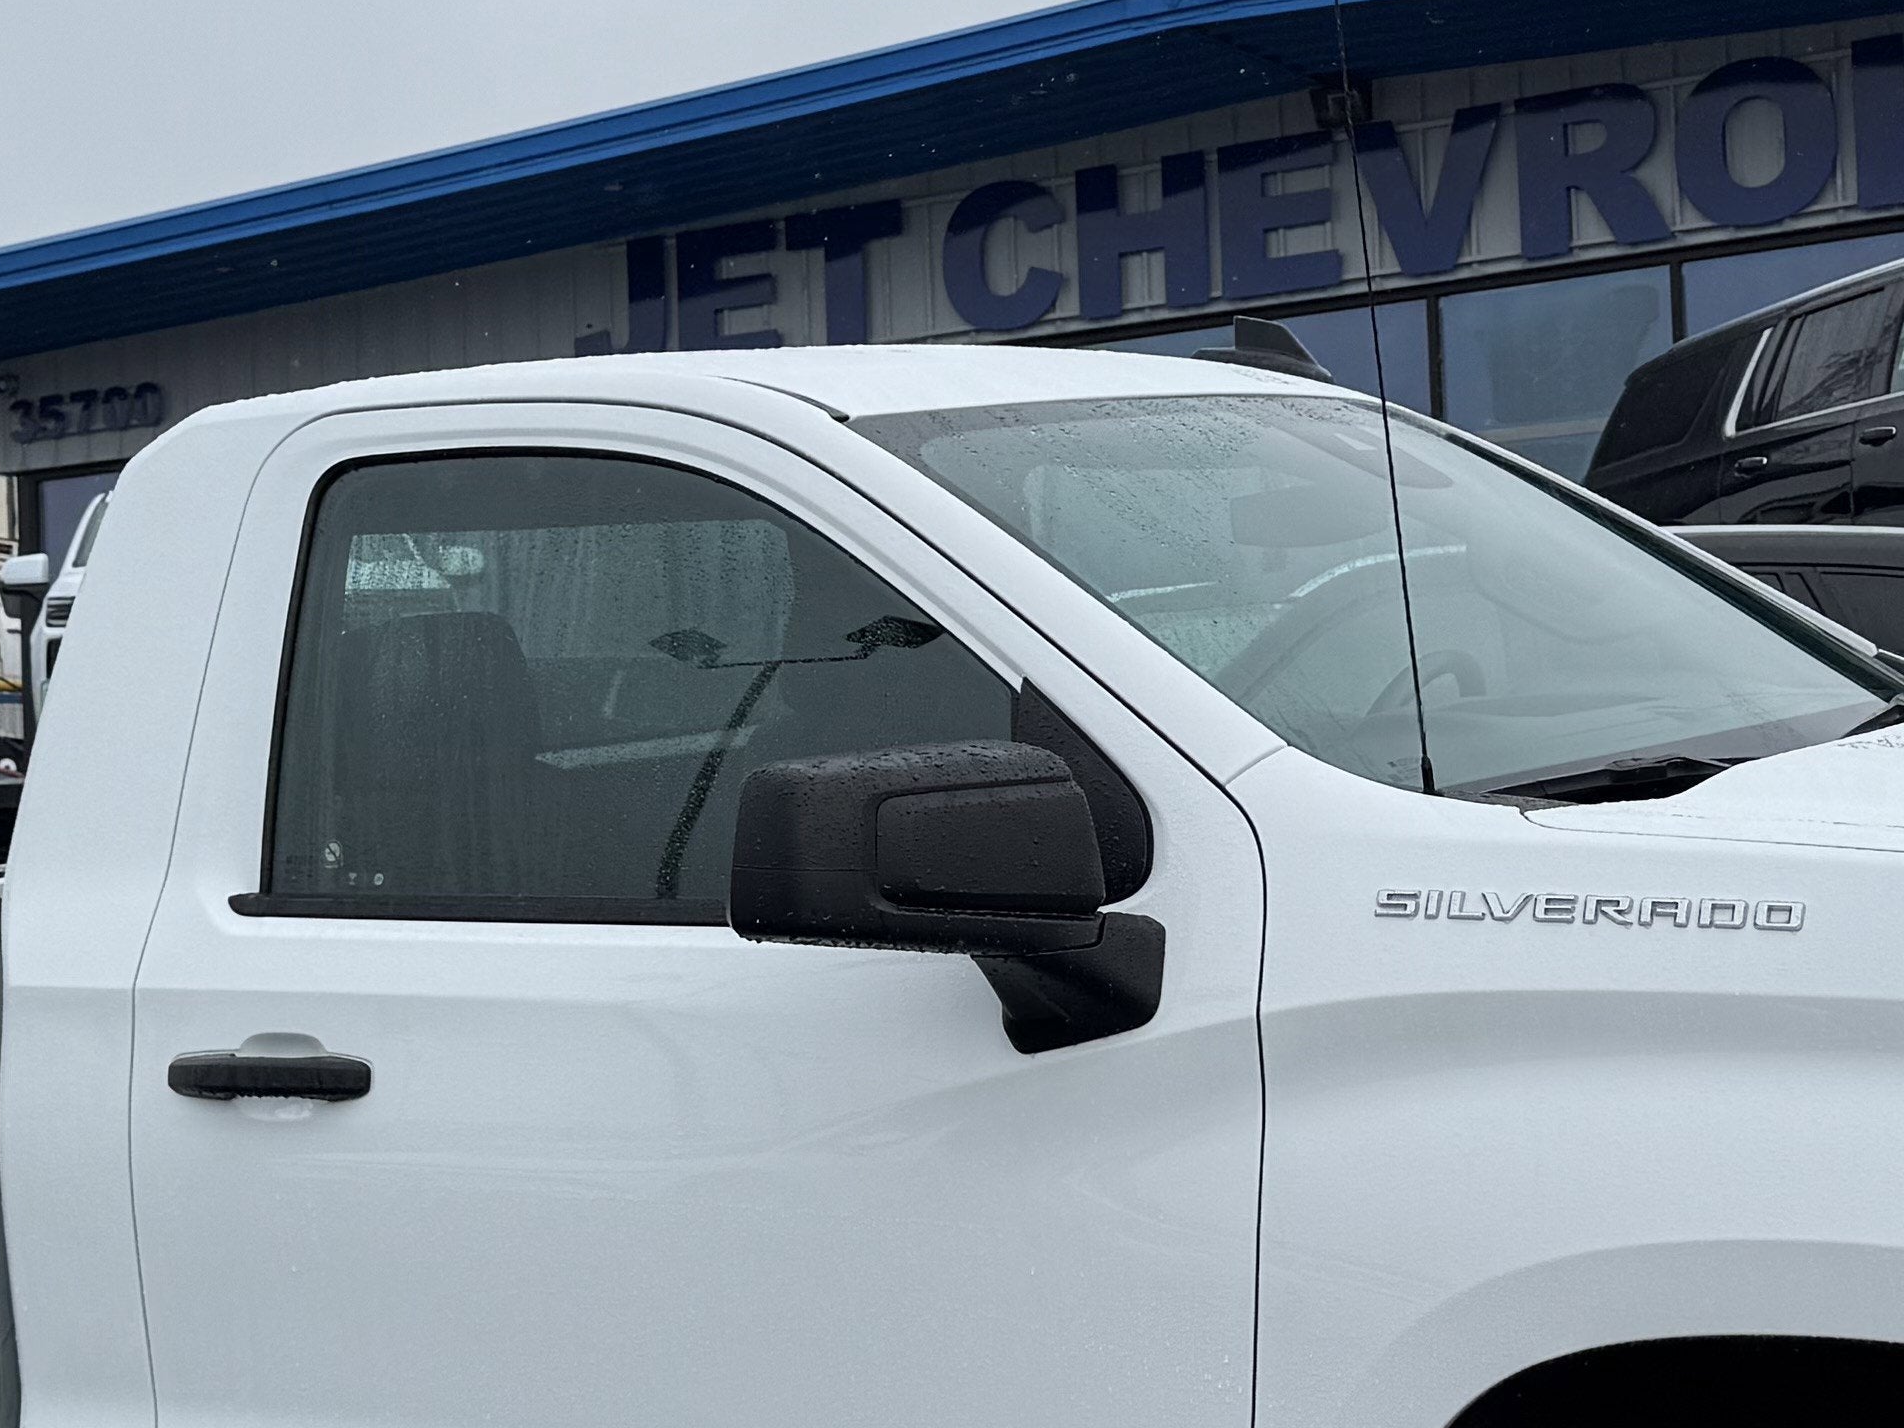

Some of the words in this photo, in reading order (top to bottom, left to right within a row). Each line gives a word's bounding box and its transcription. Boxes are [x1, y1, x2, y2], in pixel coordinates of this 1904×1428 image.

[574, 198, 902, 356] JET
[8, 381, 164, 445] 35700
[1374, 888, 1806, 932] SILVERADO
